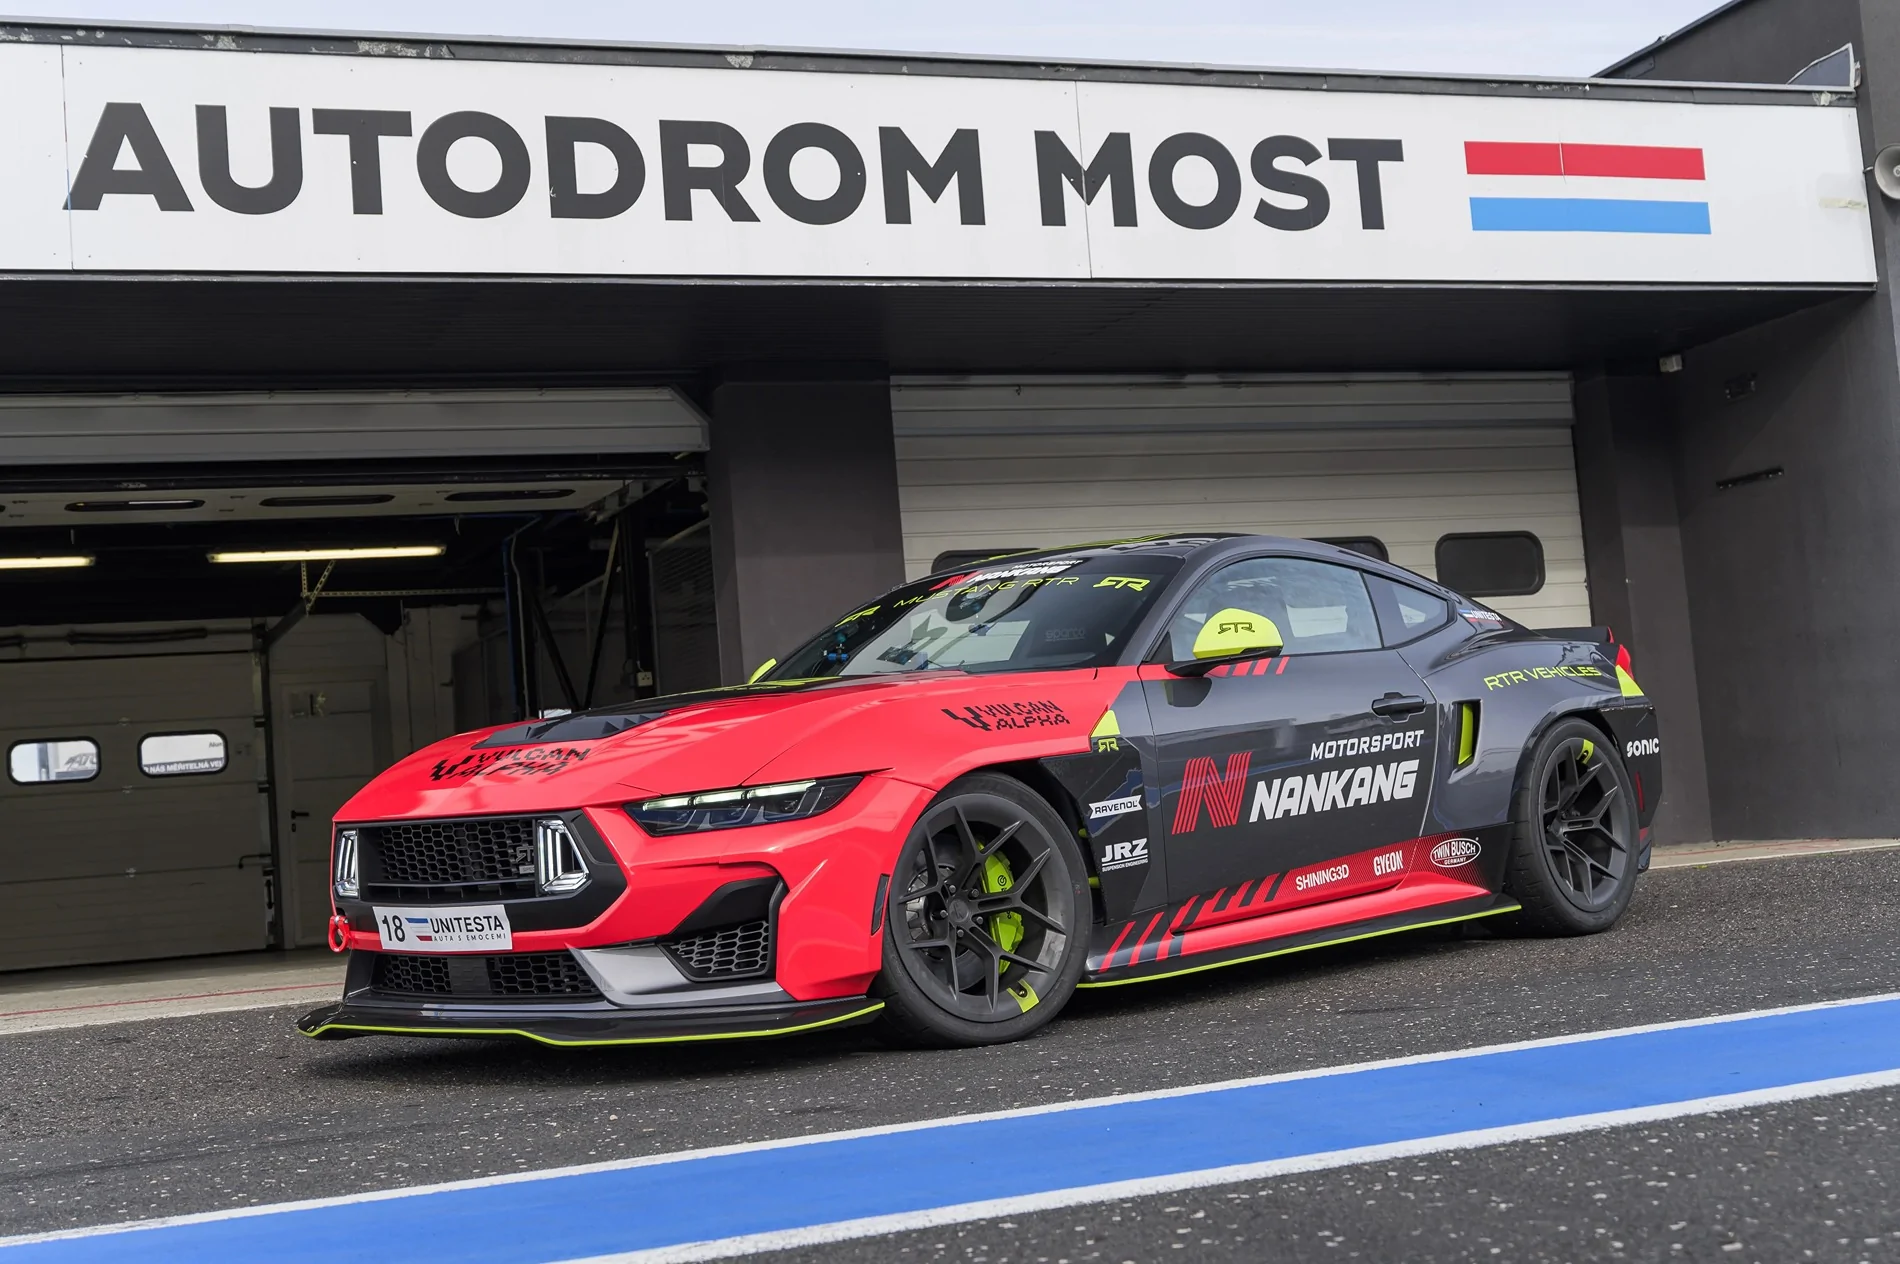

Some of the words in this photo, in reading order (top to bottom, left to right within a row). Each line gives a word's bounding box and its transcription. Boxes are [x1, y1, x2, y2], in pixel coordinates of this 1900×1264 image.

[62, 102, 986, 225] AUTODROM
[1034, 130, 1404, 231] MOST
[893, 580, 1019, 608] MUSTANG
[1021, 577, 1080, 588] RTR
[1484, 670, 1525, 691] RTR
[1526, 666, 1602, 680] VEHICLES
[975, 700, 1063, 717] VULCAN
[996, 714, 1070, 730] ALPHA
[476, 748, 591, 760] VULCAN
[1310, 729, 1425, 761] MOTORSPORT
[1249, 759, 1419, 823] NANKANG
[1094, 800, 1138, 815] RAVENOL
[1101, 838, 1148, 863] JRZ
[1433, 842, 1450, 860] TWIN
[1451, 840, 1476, 856] BUSCH
[1444, 856, 1467, 865] GERMANY
[1102, 863, 1125, 872] SUSPENSION
[1126, 858, 1148, 868] ENGINEERING
[1373, 850, 1404, 876] GYEON
[1295, 864, 1350, 891] SHINING3D
[382, 915, 406, 943] 18
[430, 915, 505, 934] UNITESTA
[466, 933, 507, 942] EMOCEMI
